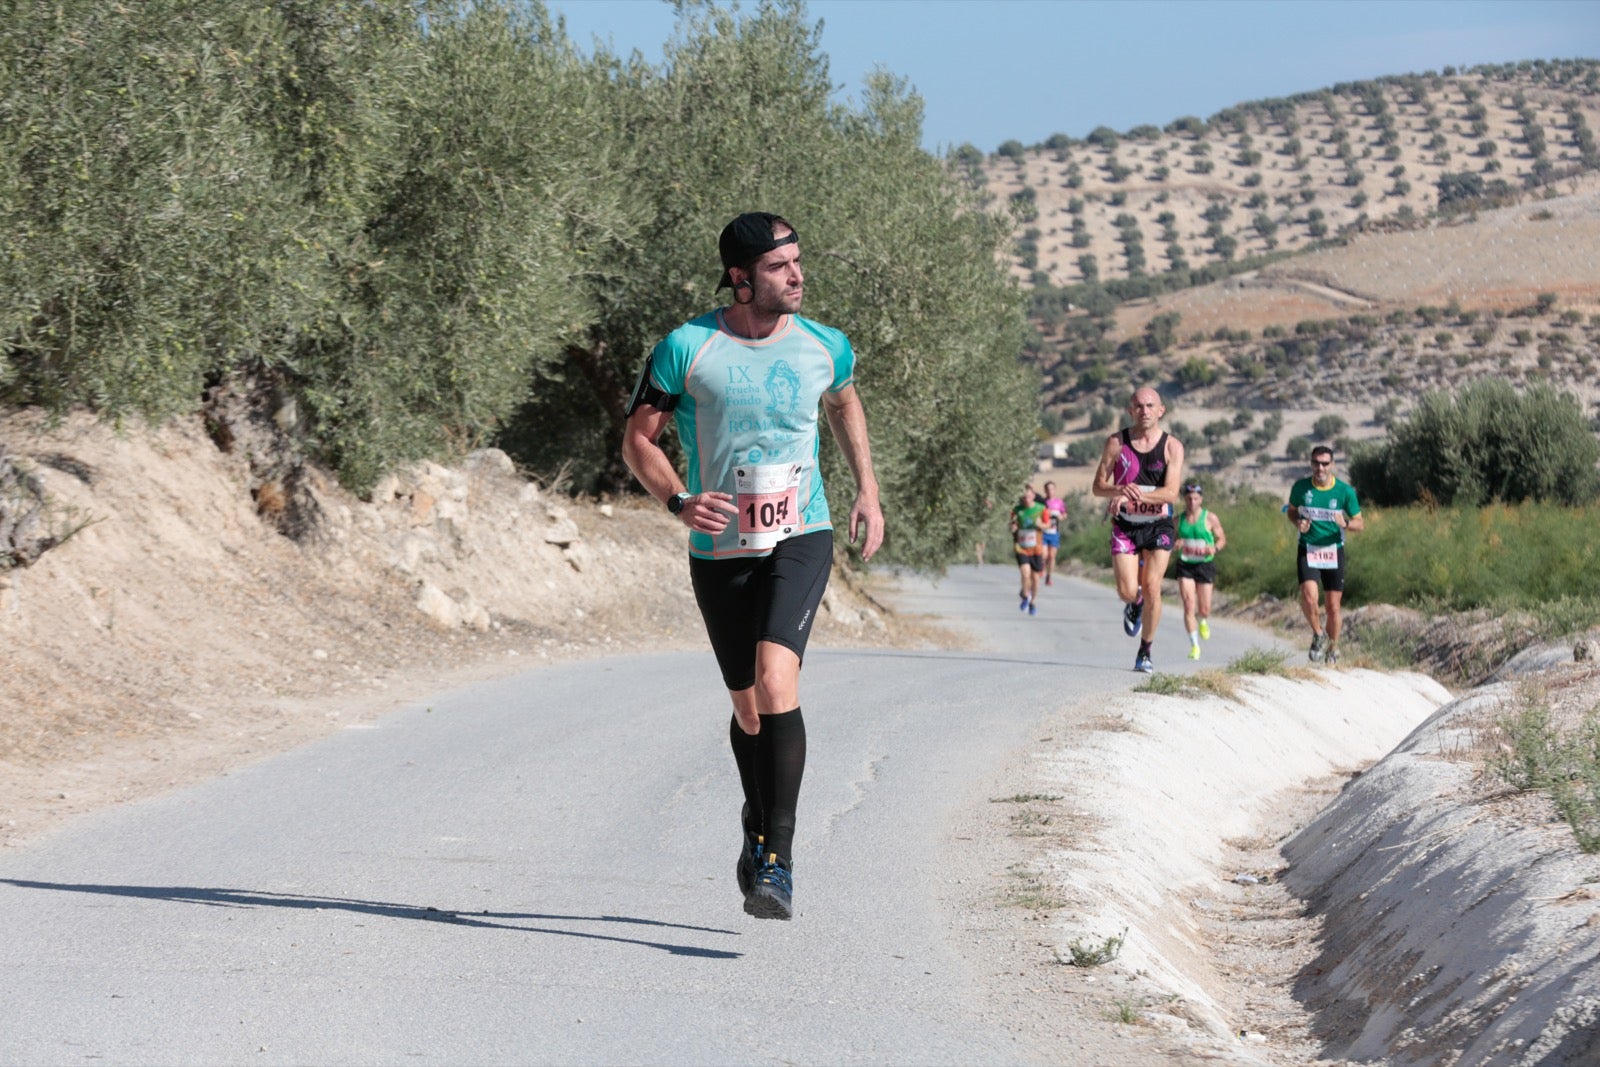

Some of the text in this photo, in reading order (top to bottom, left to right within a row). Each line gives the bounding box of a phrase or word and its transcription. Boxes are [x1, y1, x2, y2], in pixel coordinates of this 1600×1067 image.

[727, 365, 754, 384] IX
[725, 395, 762, 406] Fondo
[1132, 500, 1162, 514] 1043
